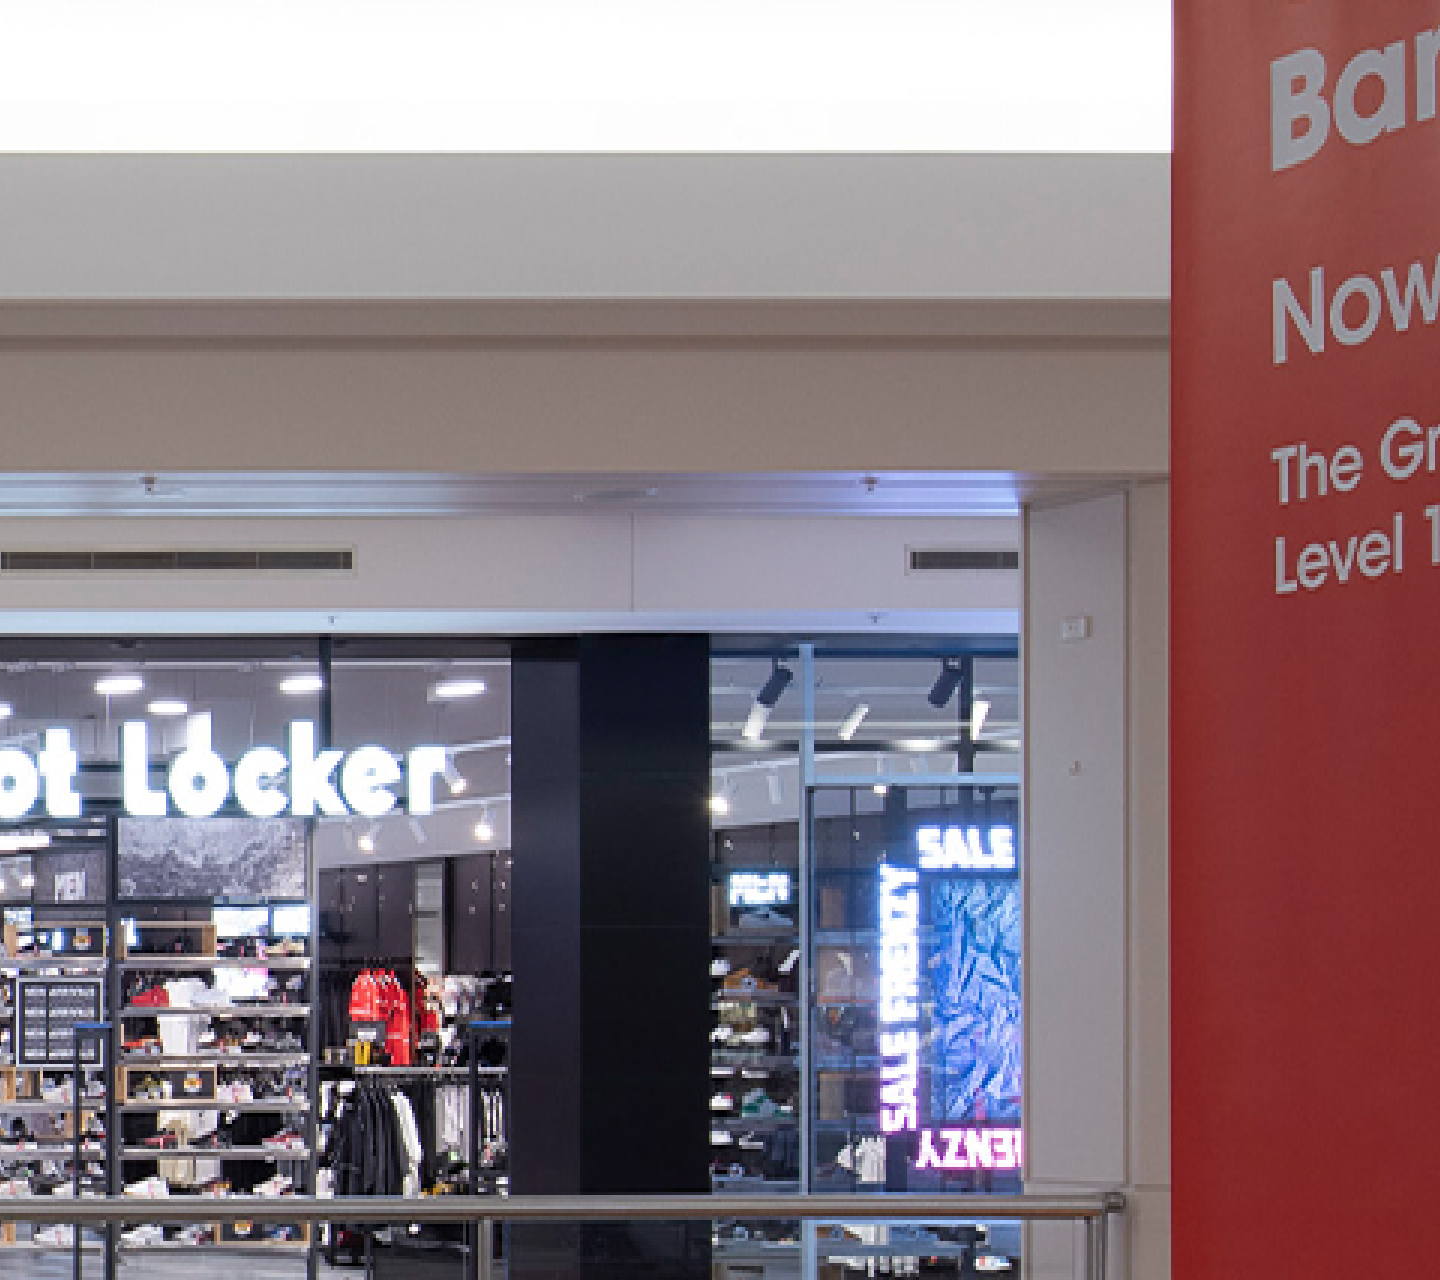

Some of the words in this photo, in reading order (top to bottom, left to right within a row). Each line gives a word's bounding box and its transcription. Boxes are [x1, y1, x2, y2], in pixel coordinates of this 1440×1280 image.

[1271, 441, 1363, 506] The
[1274, 512, 1404, 595] Level
[118, 719, 449, 819] Locker
[916, 826, 1016, 870] SALE
